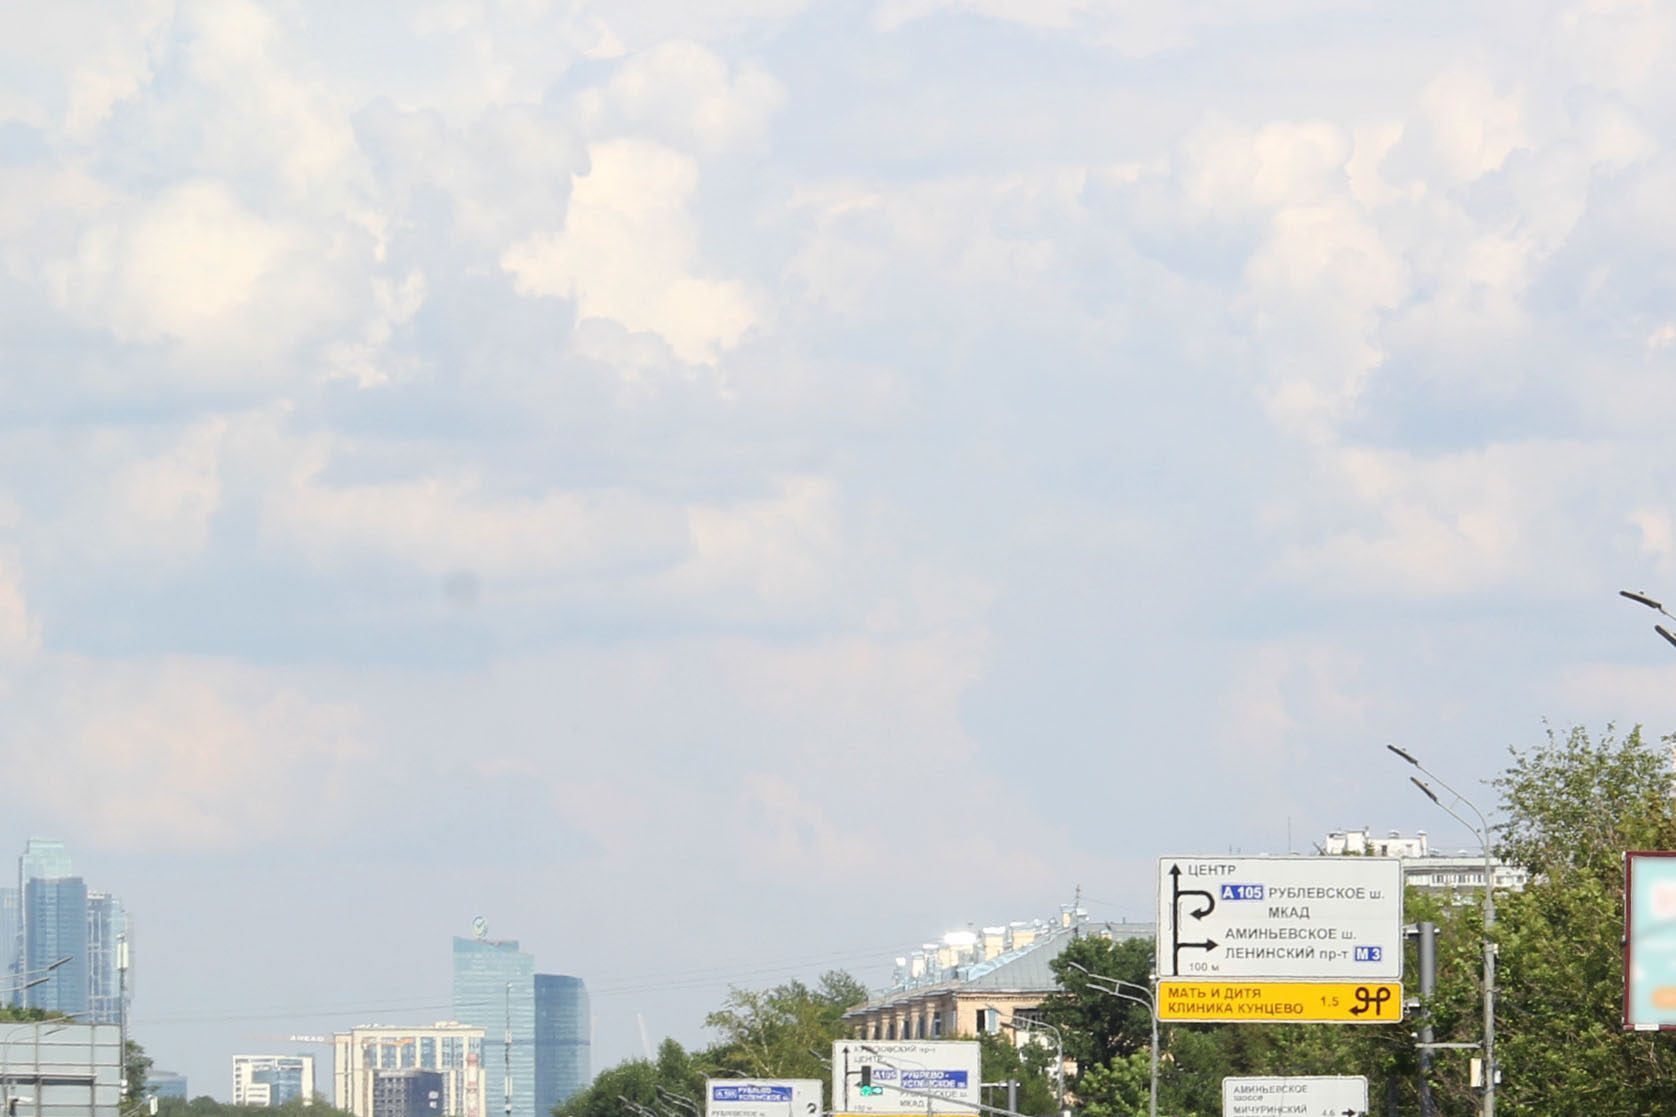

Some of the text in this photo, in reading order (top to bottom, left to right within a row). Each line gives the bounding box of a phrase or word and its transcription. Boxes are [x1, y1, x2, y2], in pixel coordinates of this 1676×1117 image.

[1188, 865, 1236, 877] ЦЕНТР
[1269, 887, 1366, 899] РУБЛЕВСКОЕ
[1369, 891, 1385, 899] ш.
[1268, 906, 1310, 919] МКАД
[1225, 928, 1357, 940] АМИНЬЕВСКОЕ ш.
[1225, 946, 1315, 959] ЛЕНИНСКИЙ
[1319, 950, 1349, 962] пр-т
[1189, 963, 1208, 972] 100
[1168, 987, 1339, 1007] МАТЬ И ДИТЯ 1.5
[1168, 1002, 1304, 1015] КЛИНИКА КУНЦЕВО
[1233, 1084, 1308, 1094] АМИНЬЕВСКОЕ
[1233, 1104, 1307, 1113] МИЧУРИНСКИЙ
